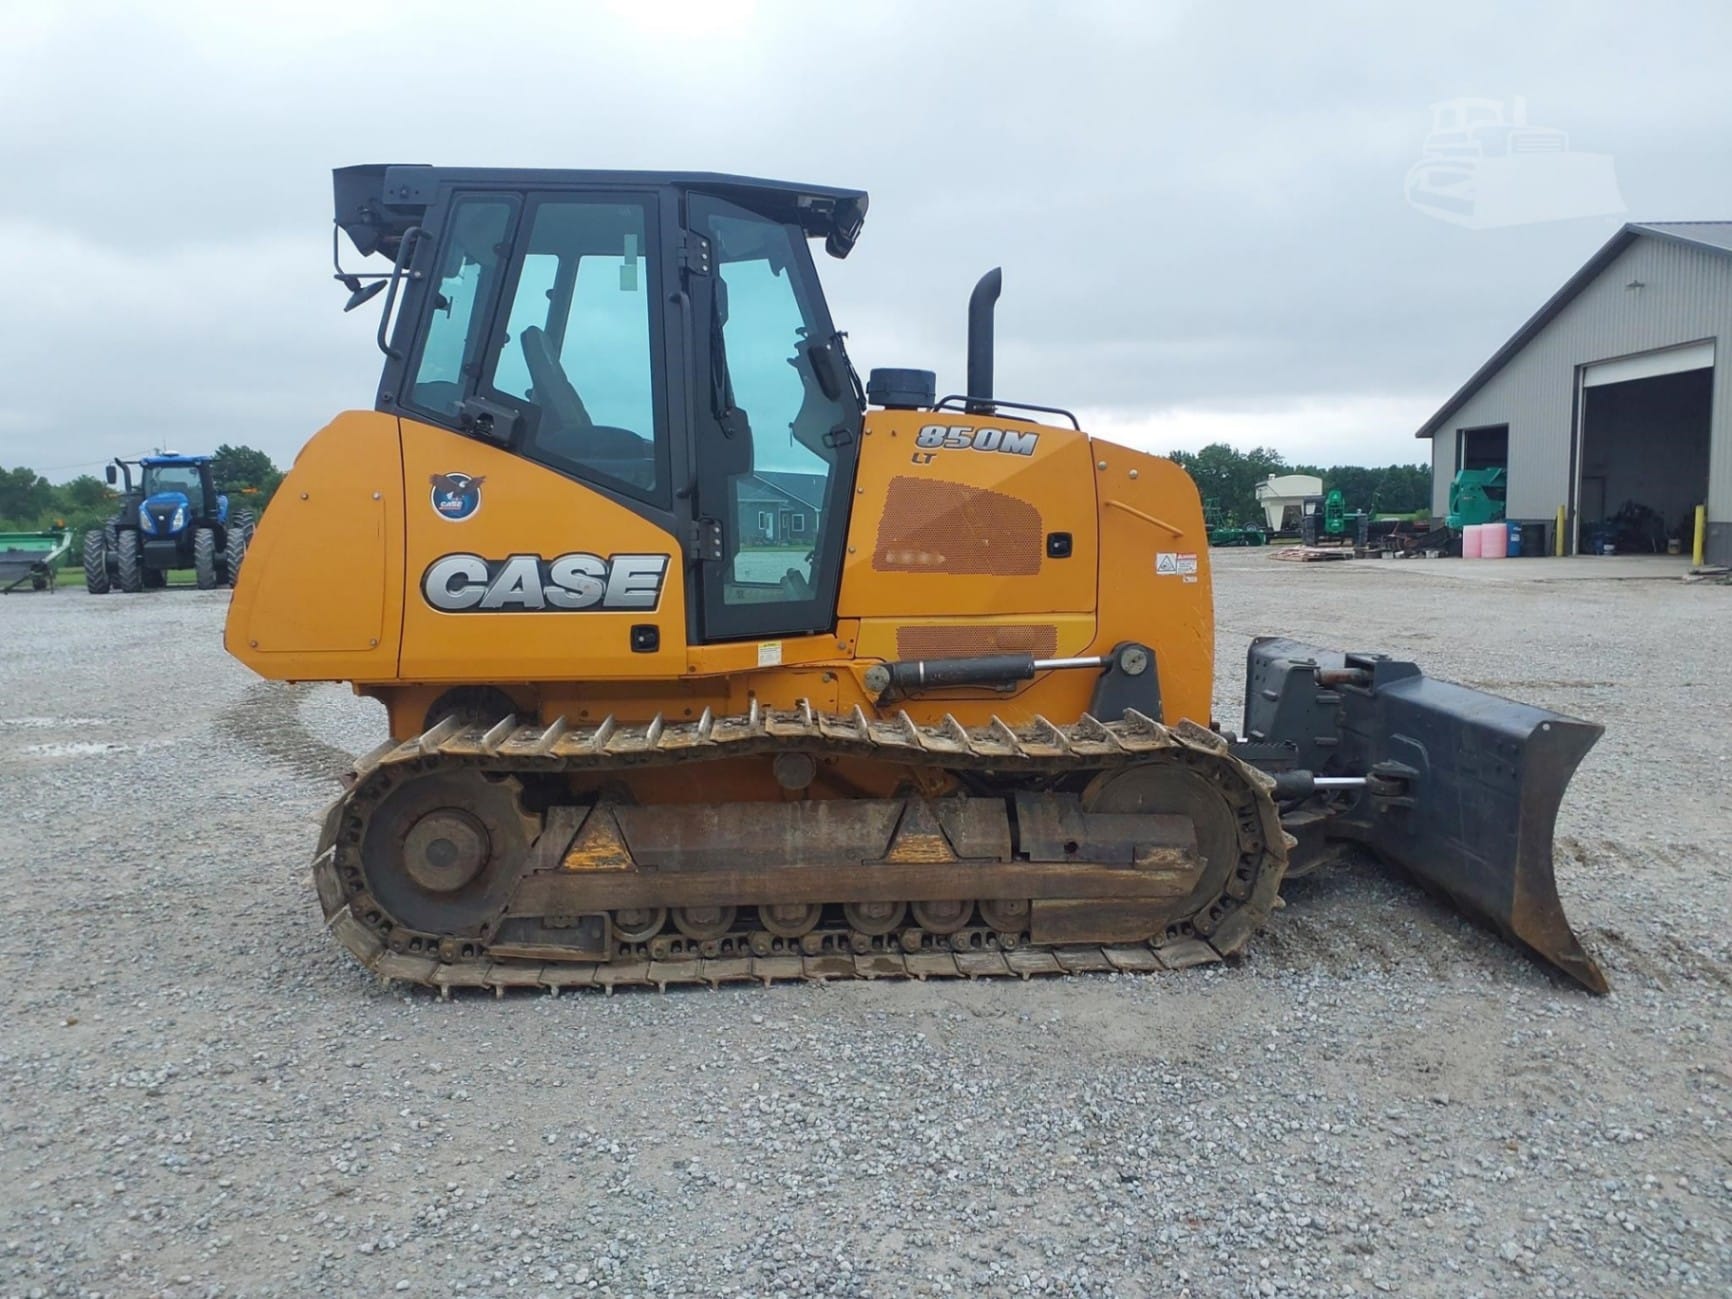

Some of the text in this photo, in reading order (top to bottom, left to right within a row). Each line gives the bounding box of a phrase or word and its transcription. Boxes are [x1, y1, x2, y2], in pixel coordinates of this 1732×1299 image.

[916, 424, 1039, 456] 850M
[911, 452, 937, 465] LT
[422, 553, 669, 611] CASE
